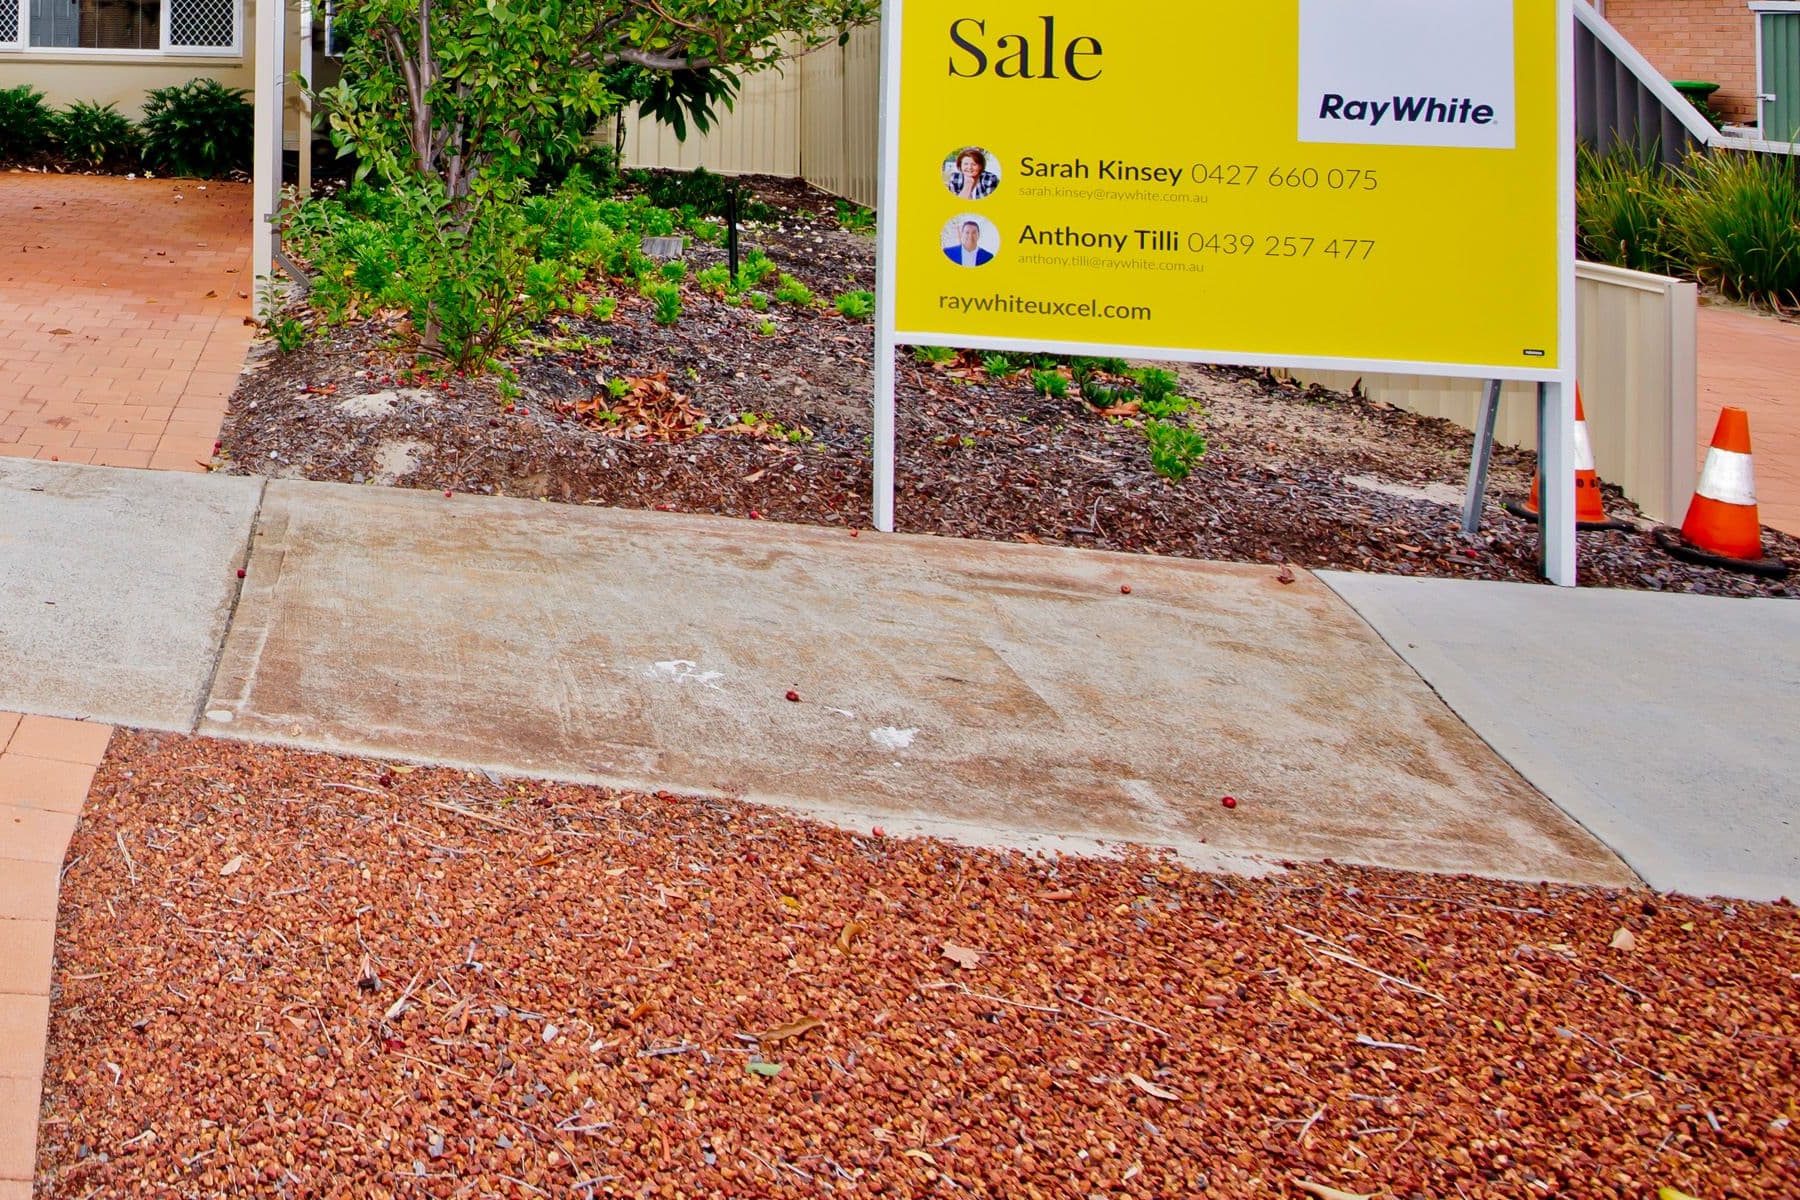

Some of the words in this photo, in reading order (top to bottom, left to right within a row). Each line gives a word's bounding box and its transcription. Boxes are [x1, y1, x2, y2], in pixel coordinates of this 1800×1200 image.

[948, 15, 1103, 81] Sale
[1319, 93, 1495, 126] RayWhite
[1020, 156, 1089, 179] Sarah
[1098, 159, 1183, 187] Kinsey
[1191, 163, 1259, 185] 0427
[1268, 166, 1319, 188] 660
[1327, 168, 1378, 191] 075
[1018, 186, 1208, 204] sarah.kinsey@raywhite.com.au
[1018, 224, 1128, 253] Anthony
[1133, 229, 1179, 252] Tilli
[1187, 232, 1255, 255] 0439
[1265, 235, 1315, 257] 257
[1323, 238, 1376, 261] 477
[1017, 253, 1205, 273] anthony.tilli@raywhite.com.au
[938, 293, 1152, 321] raywhiteuxcel.com
